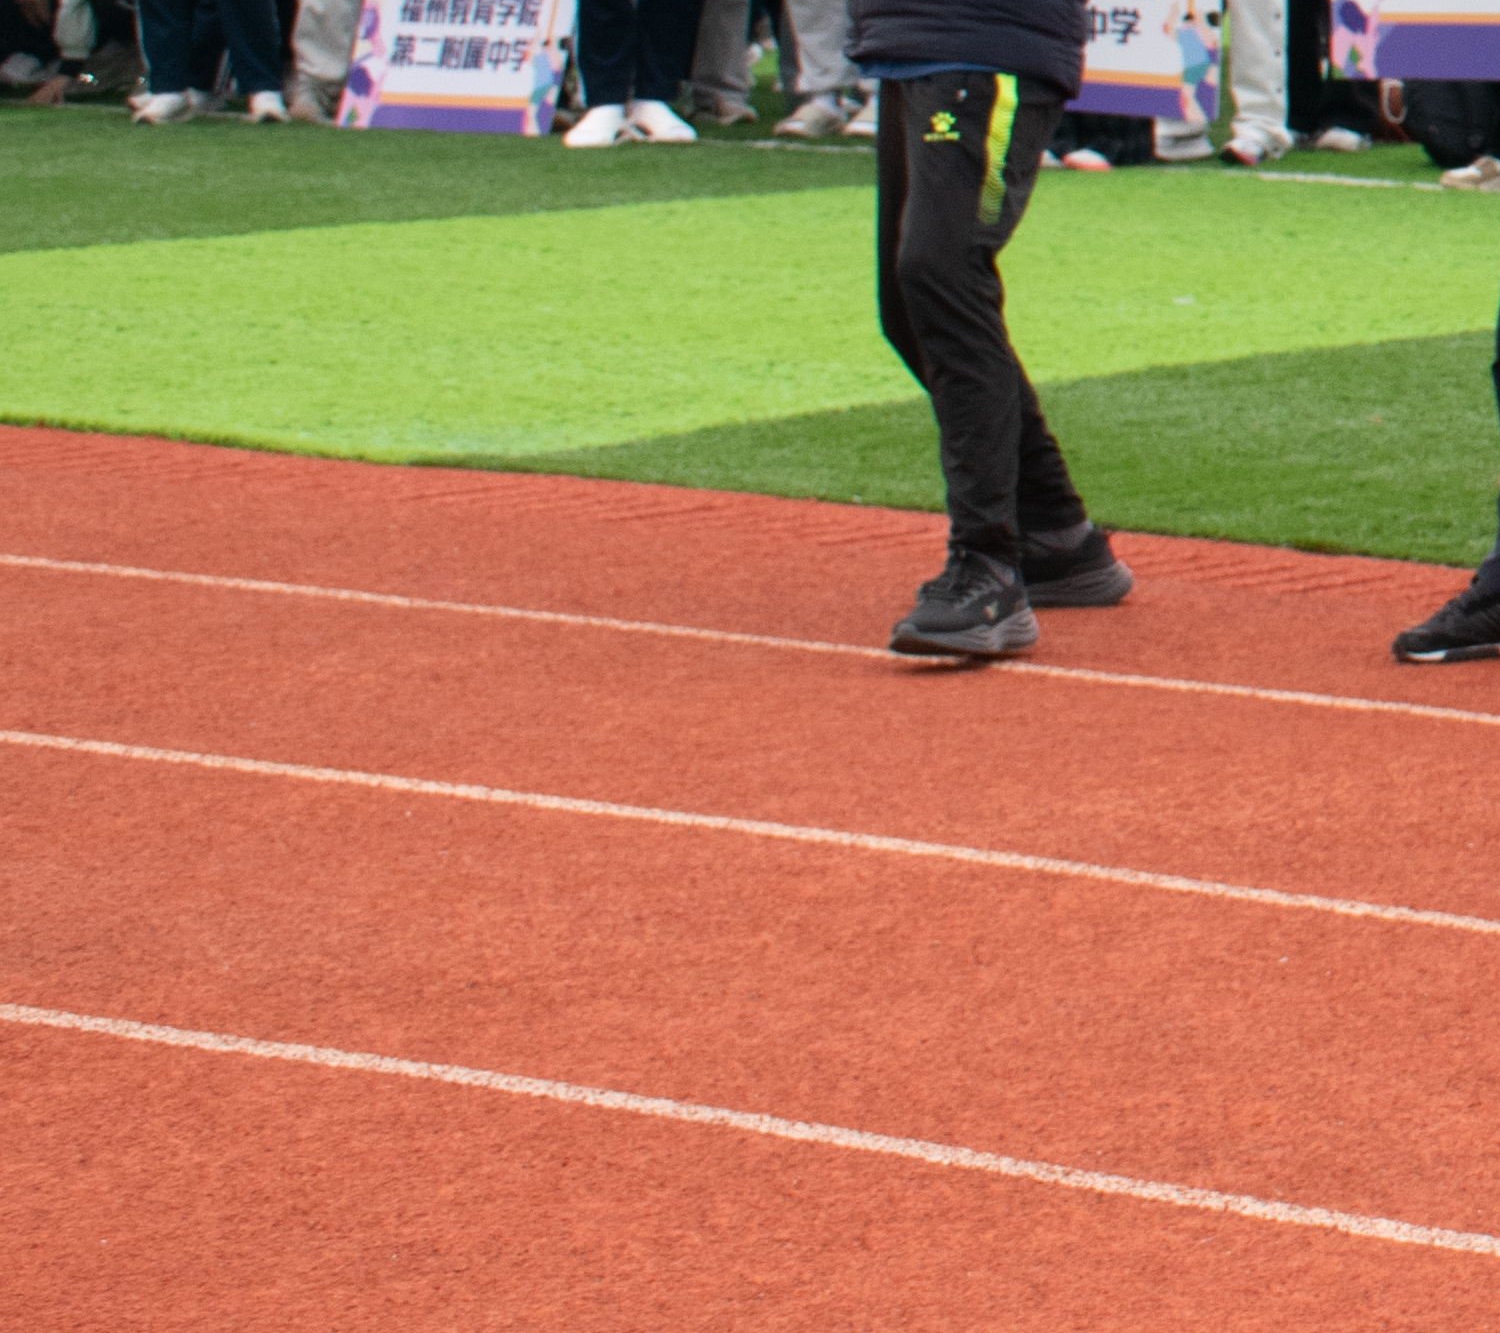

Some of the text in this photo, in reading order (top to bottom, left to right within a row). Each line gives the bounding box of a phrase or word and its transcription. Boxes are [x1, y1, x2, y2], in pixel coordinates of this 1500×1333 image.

[390, 34, 533, 72] 第二附属中学
